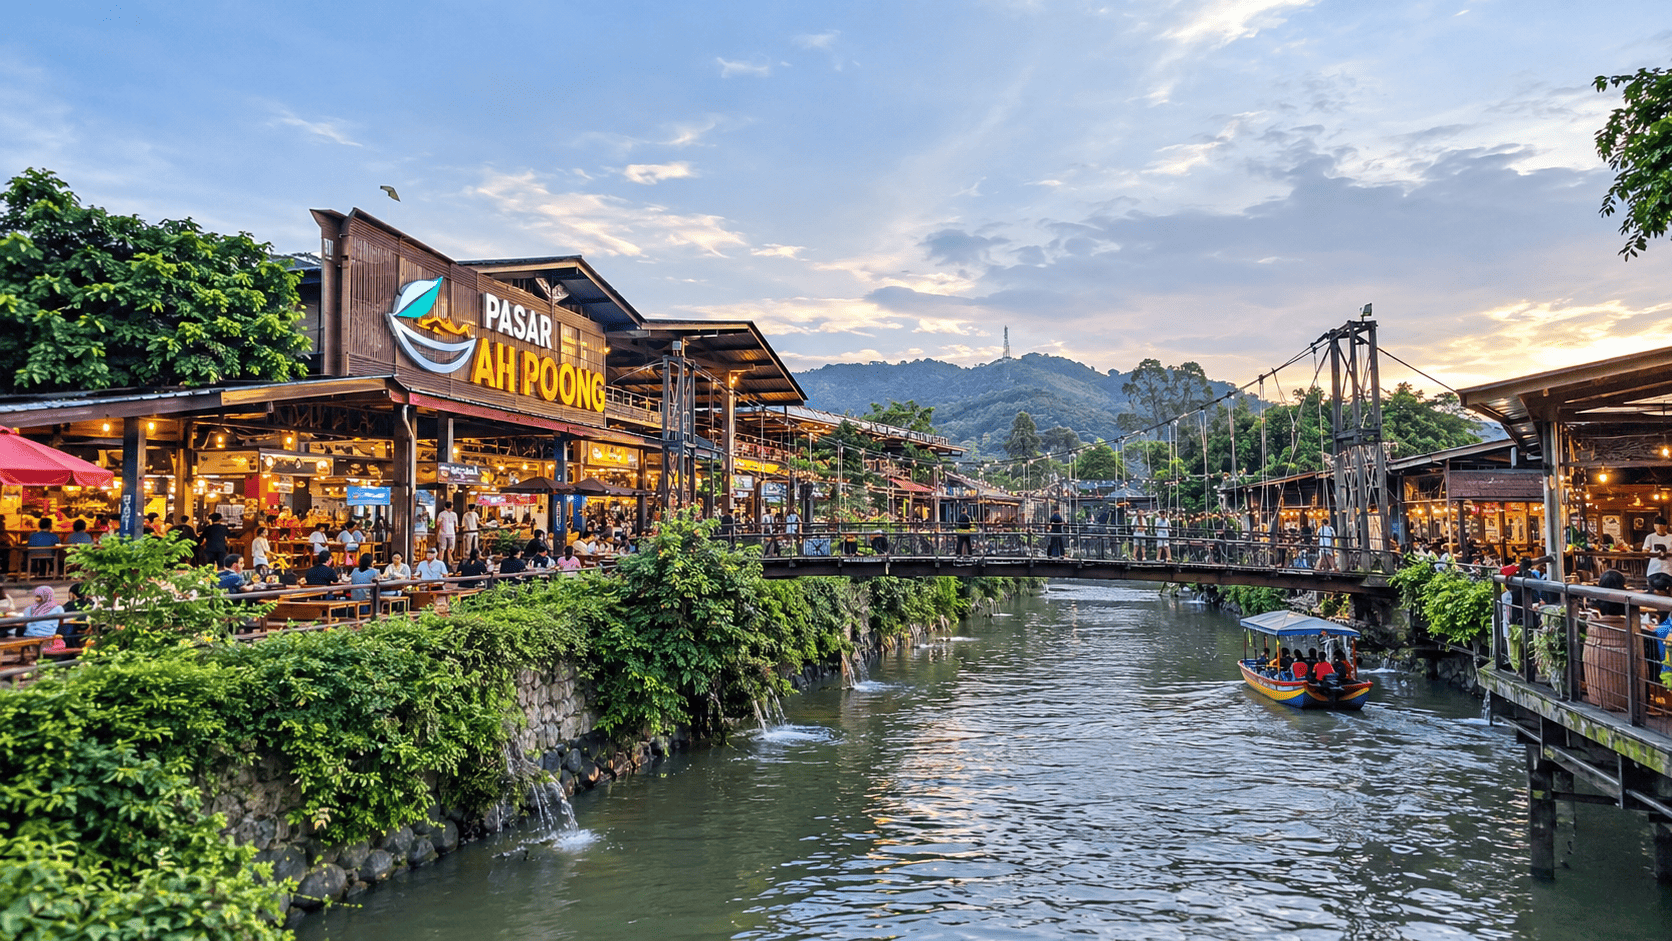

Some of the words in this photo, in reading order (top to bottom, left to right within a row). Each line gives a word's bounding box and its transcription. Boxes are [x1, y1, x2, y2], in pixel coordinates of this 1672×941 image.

[484, 292, 553, 350] PASAR
[472, 337, 516, 393] AH
[520, 350, 606, 413] POONG
